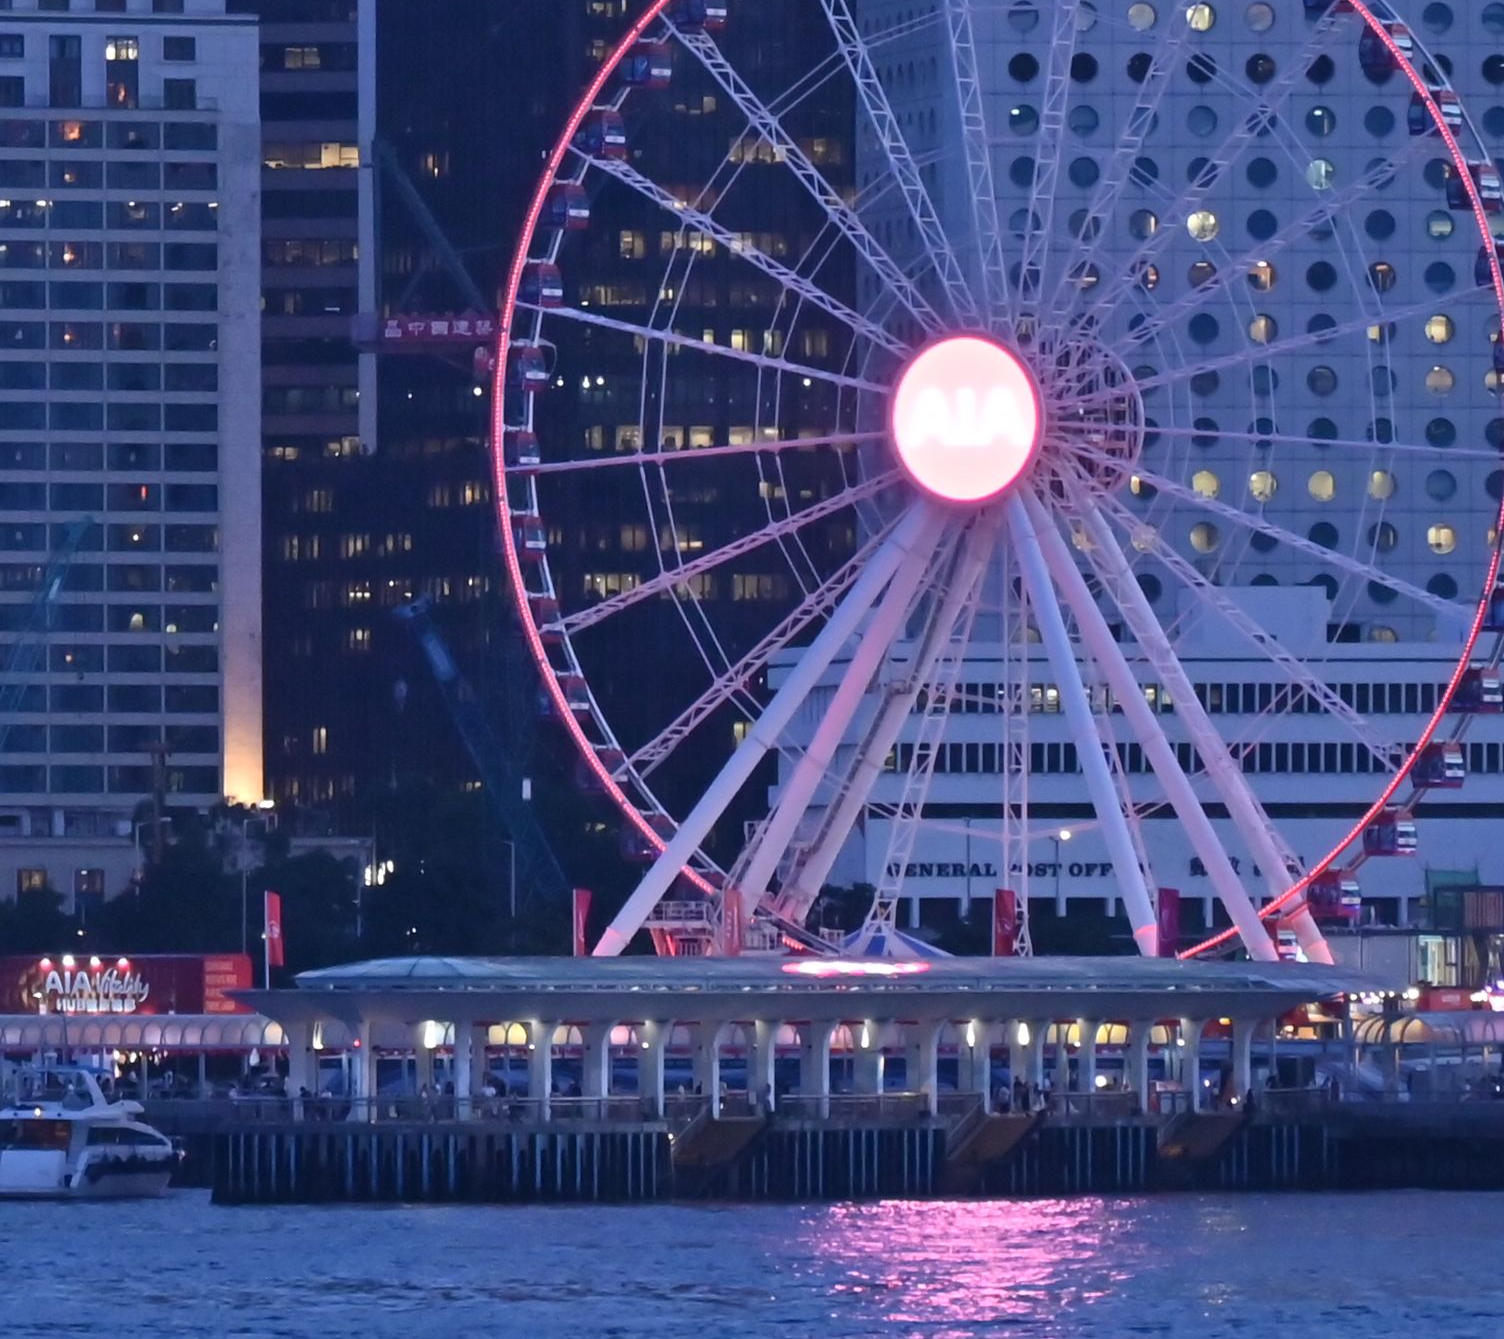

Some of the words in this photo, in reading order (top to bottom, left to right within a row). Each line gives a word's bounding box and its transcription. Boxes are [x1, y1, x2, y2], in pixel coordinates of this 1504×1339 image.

[906, 386, 1028, 448] AIA
[886, 862, 998, 878] GENERAL
[44, 970, 92, 995] AIA
[96, 967, 150, 1003] Vitality
